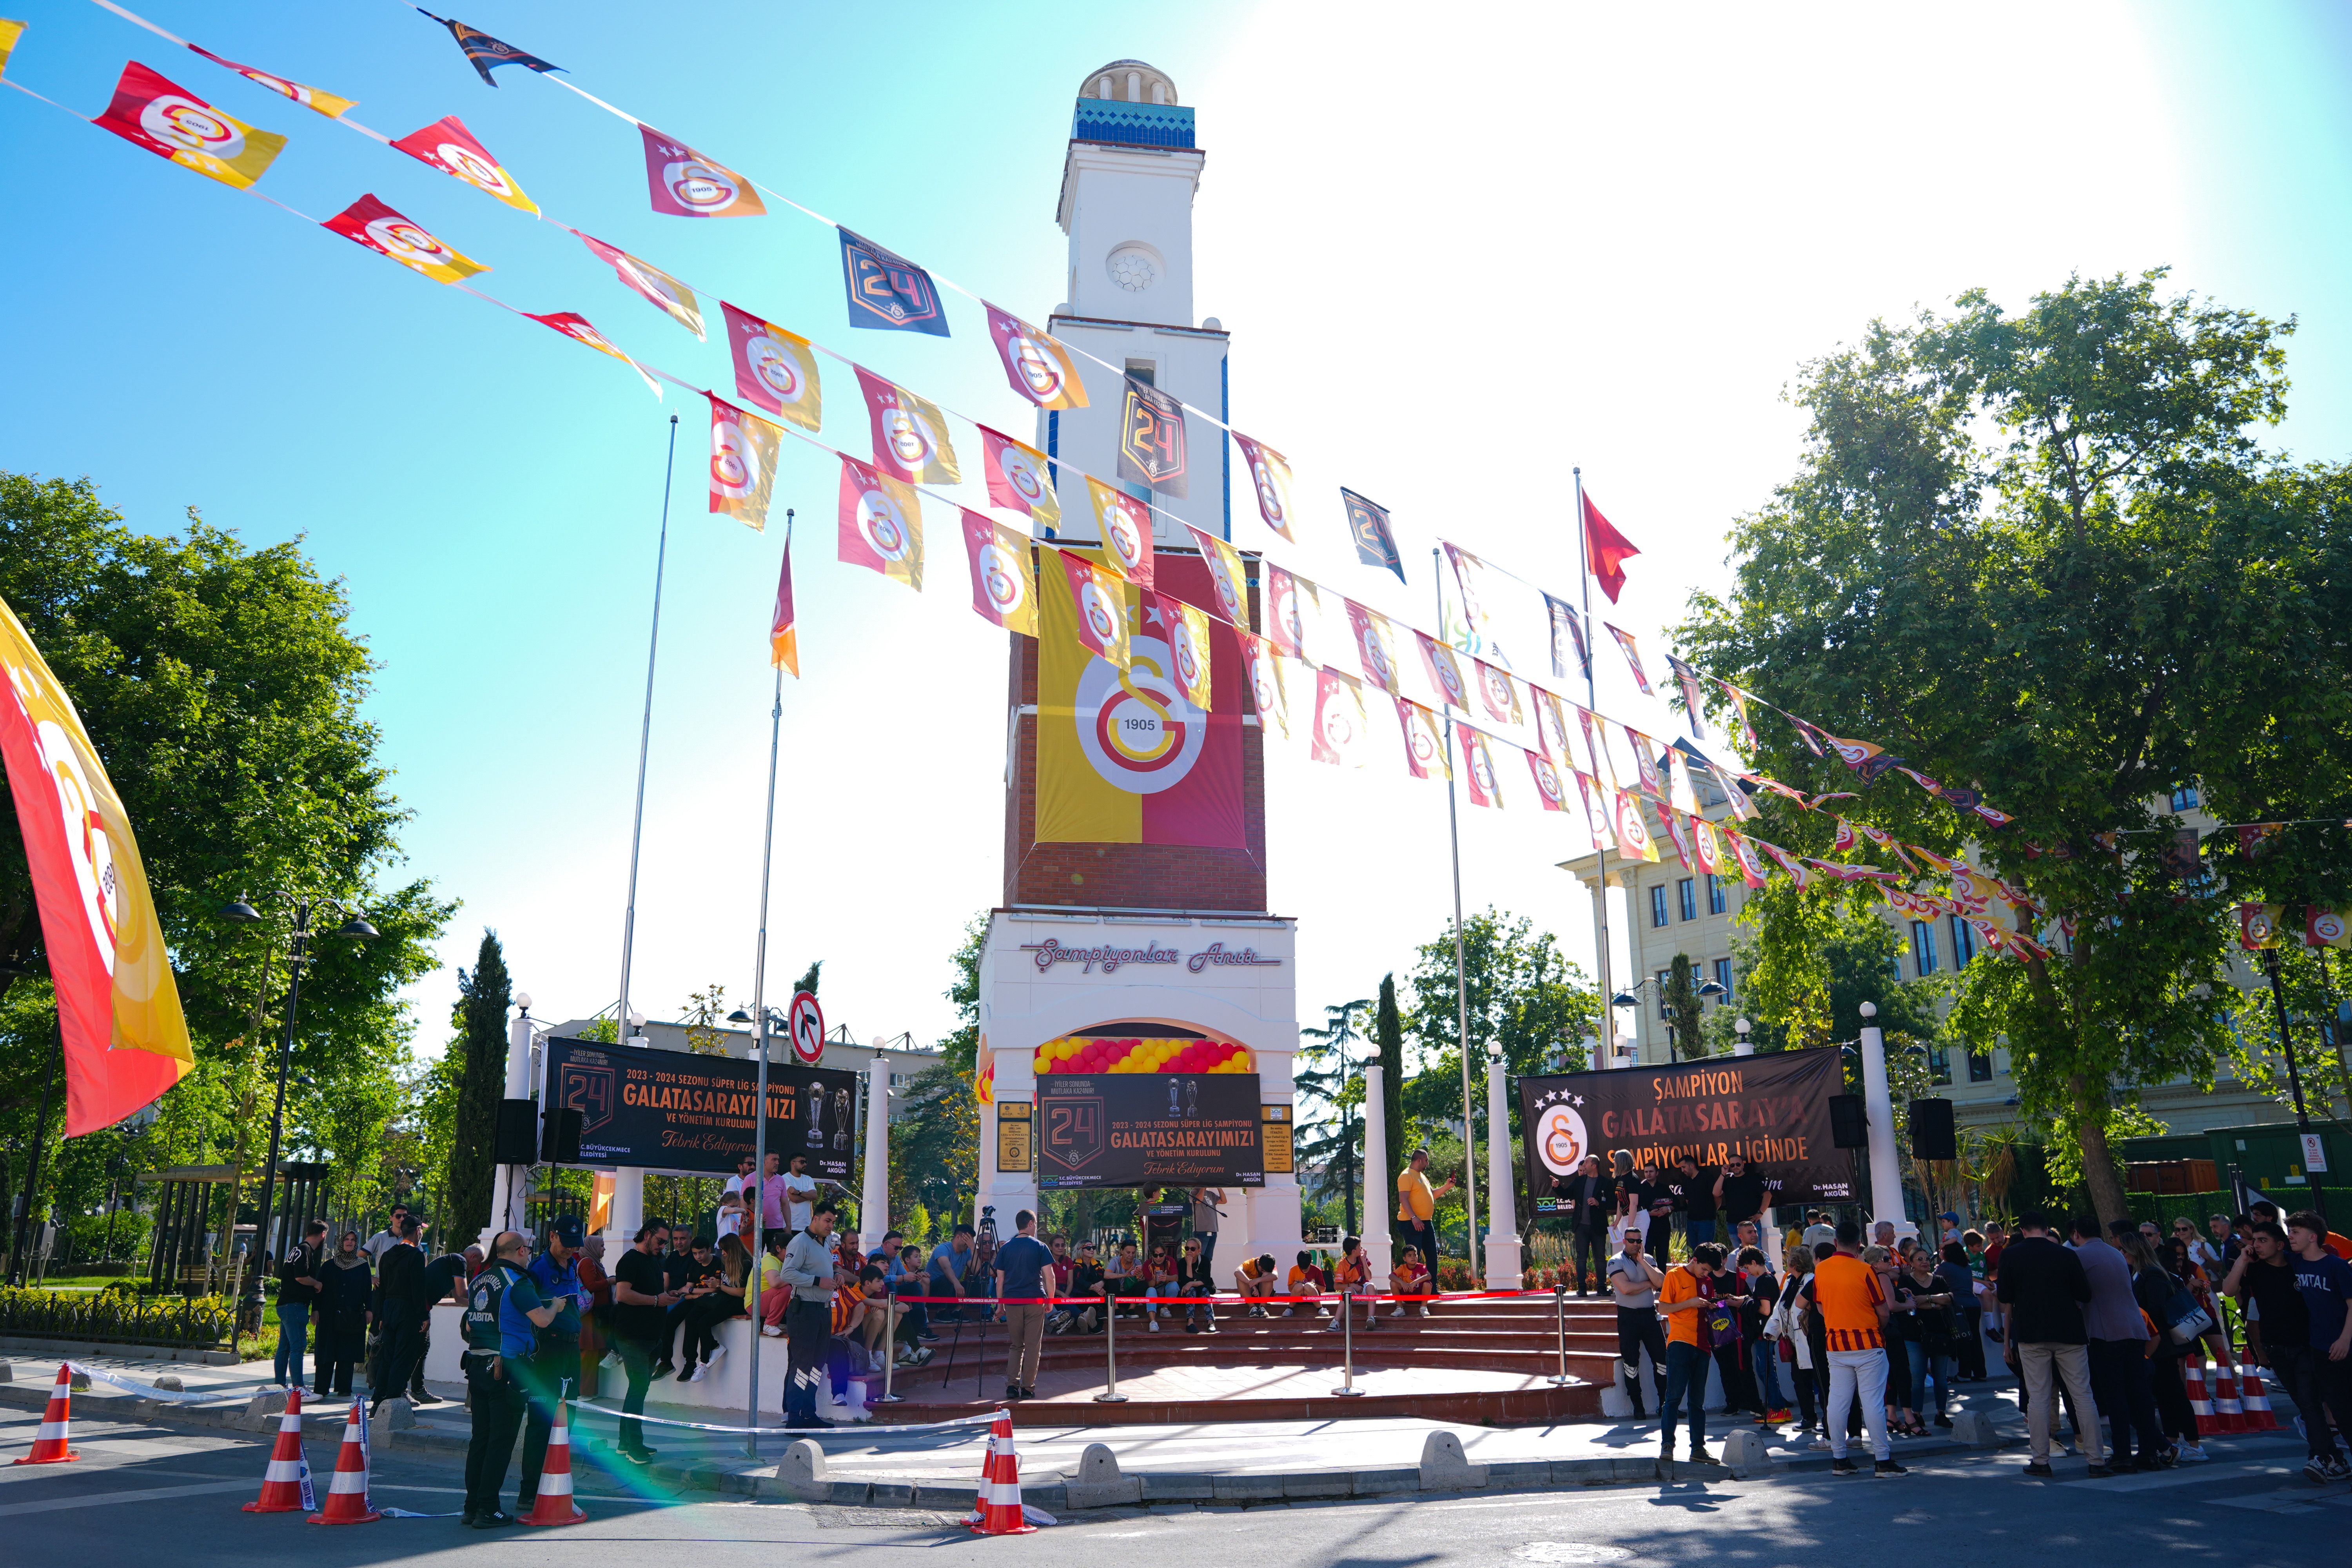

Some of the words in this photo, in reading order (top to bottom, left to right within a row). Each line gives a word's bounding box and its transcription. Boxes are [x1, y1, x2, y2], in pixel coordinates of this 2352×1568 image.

[187, 120, 209, 131] 1905
[860, 259, 921, 307] 24
[1134, 408, 1173, 462] 24
[1265, 495, 1275, 505] 1905
[1354, 509, 1390, 551] 24
[1124, 719, 1155, 731] 1905
[1020, 938, 1179, 973] Şampiyonlar
[1187, 942, 1281, 974] Anıtı
[626, 1069, 647, 1080] 2023
[656, 1072, 675, 1083] 2024
[679, 1074, 709, 1086] SEZONU
[711, 1076, 735, 1089] SÜPER
[737, 1079, 749, 1091] LİG
[751, 1082, 795, 1095] ŞAPİYONU
[1653, 1069, 1743, 1105] ŞAMPİYON
[568, 1075, 606, 1111] 24
[666, 1113, 676, 1123] VE
[679, 1112, 713, 1126] YÖNETİM
[715, 1117, 756, 1129] KURULUNU
[1203, 1119, 1212, 1127] LİG
[1215, 1119, 1252, 1129] ŞAMPİYONU
[1602, 1096, 1808, 1138] GALATASARAY'A
[1051, 1108, 1094, 1145] 24
[662, 1130, 699, 1148] Tebrik
[1111, 1130, 1254, 1148] GALATASARAYIMIZI
[1156, 1148, 1185, 1157] YÖNETİM
[1143, 1162, 1175, 1175] Tebrik
[1177, 1161, 1225, 1178] Ediyorum
[468, 1312, 494, 1322] ZABITA
[1713, 1319, 1728, 1329] gratis
